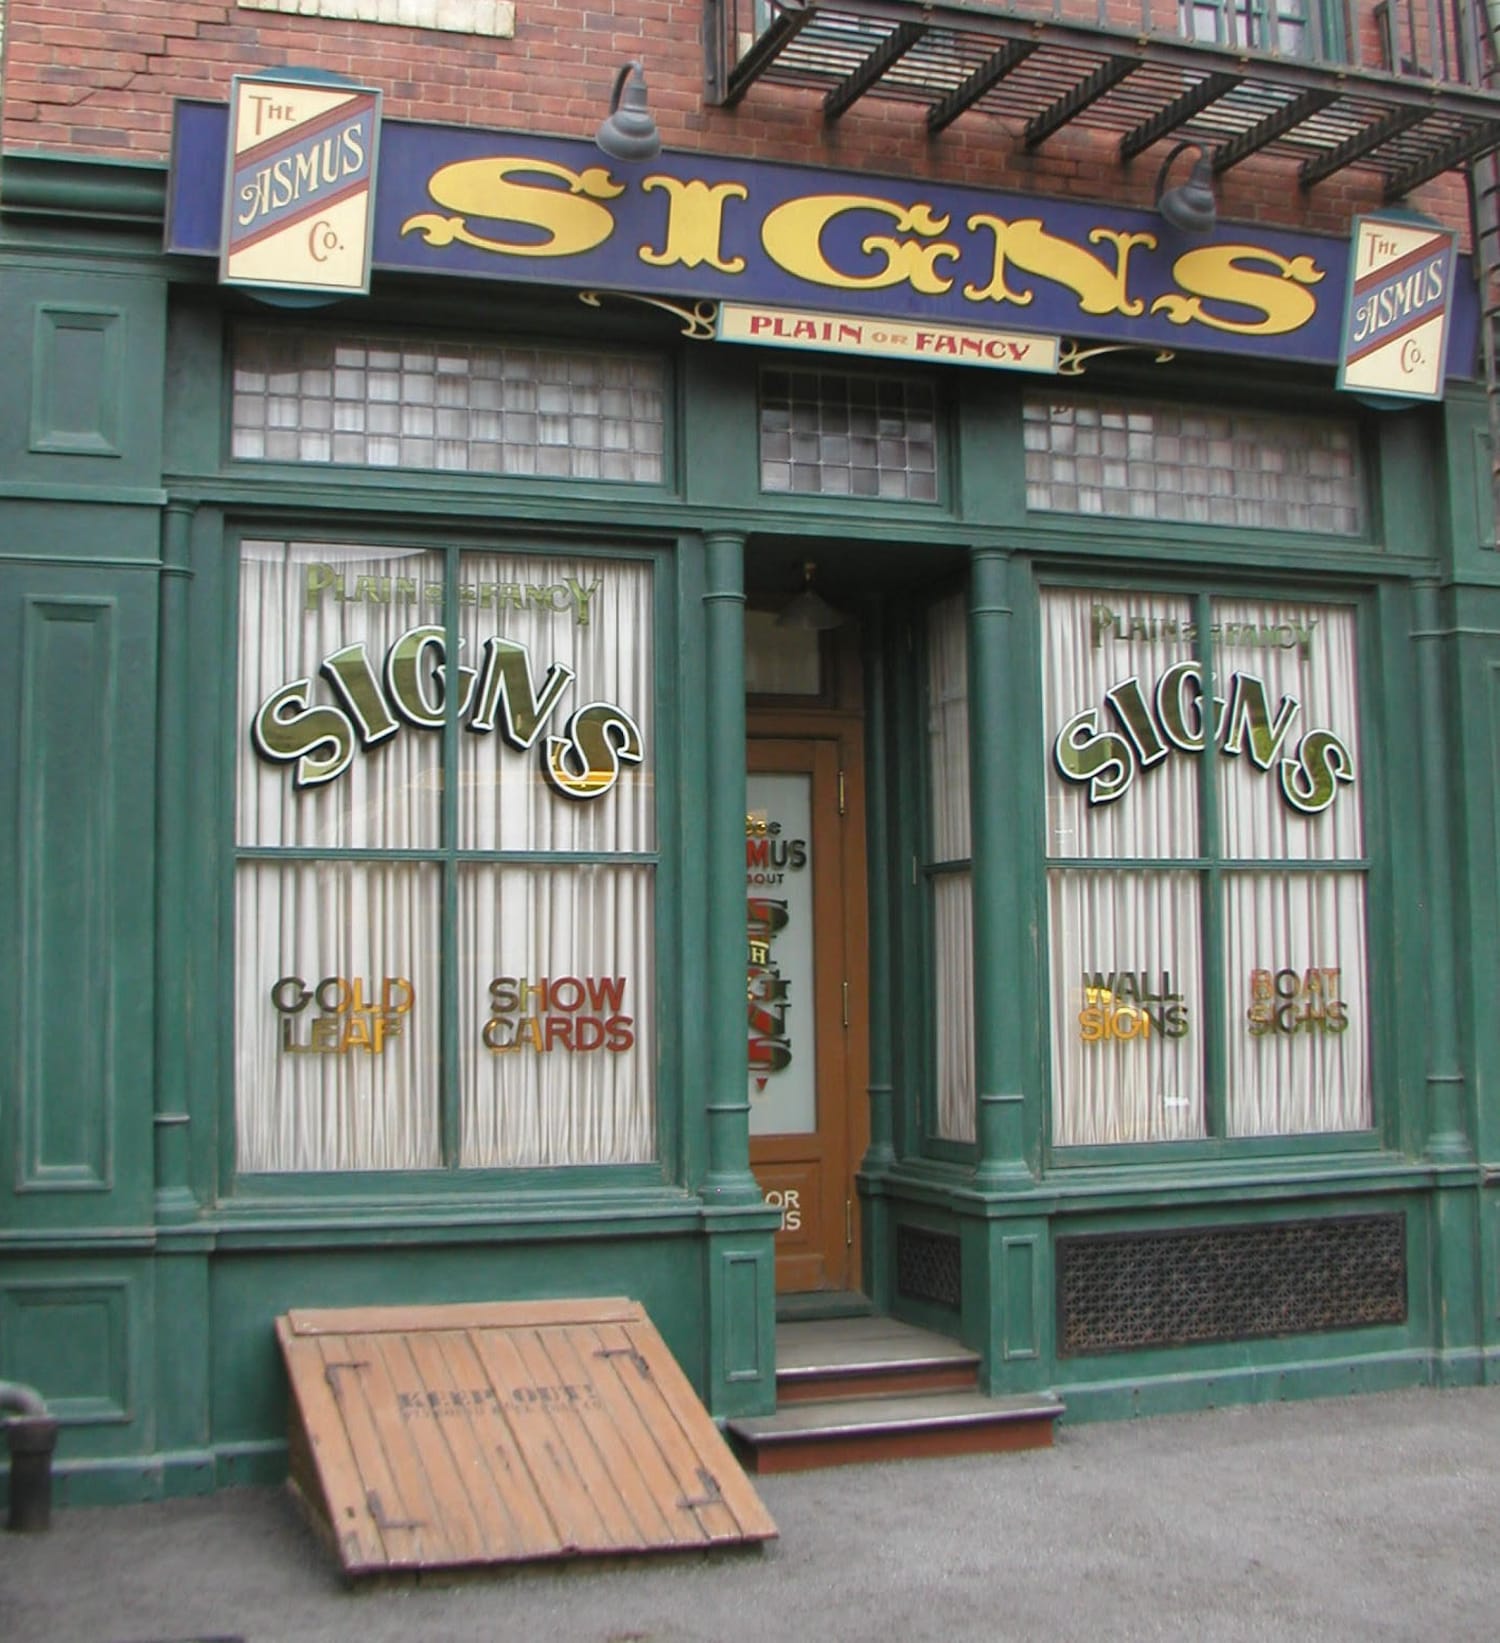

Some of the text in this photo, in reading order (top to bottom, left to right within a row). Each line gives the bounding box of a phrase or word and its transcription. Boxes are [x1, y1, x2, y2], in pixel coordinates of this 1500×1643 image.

[248, 95, 297, 136] THE
[238, 123, 364, 226] ASMUS
[308, 220, 344, 262] CO.
[400, 156, 1326, 336] SIGNS
[1366, 232, 1398, 267] THE
[1353, 258, 1443, 342] ASMUS
[750, 315, 1030, 361] PLAIN OR FANCY
[304, 562, 418, 612] PLAIN
[480, 577, 603, 626] FANCY
[1092, 603, 1178, 649] PLAIN
[1225, 618, 1319, 661] FANCY
[252, 624, 645, 800] SIGNS
[1055, 660, 1355, 813] SIGNS
[271, 976, 416, 1014] GOLD
[488, 976, 627, 1013] SHOW
[1082, 969, 1184, 1003] WALL
[1252, 968, 1342, 1000] BOAT
[282, 1017, 403, 1054] LEAF
[481, 1016, 635, 1054] CARDS
[1079, 1005, 1189, 1041] SIGNS
[1247, 1001, 1349, 1037] SIGNS
[398, 1388, 496, 1408] KEEP
